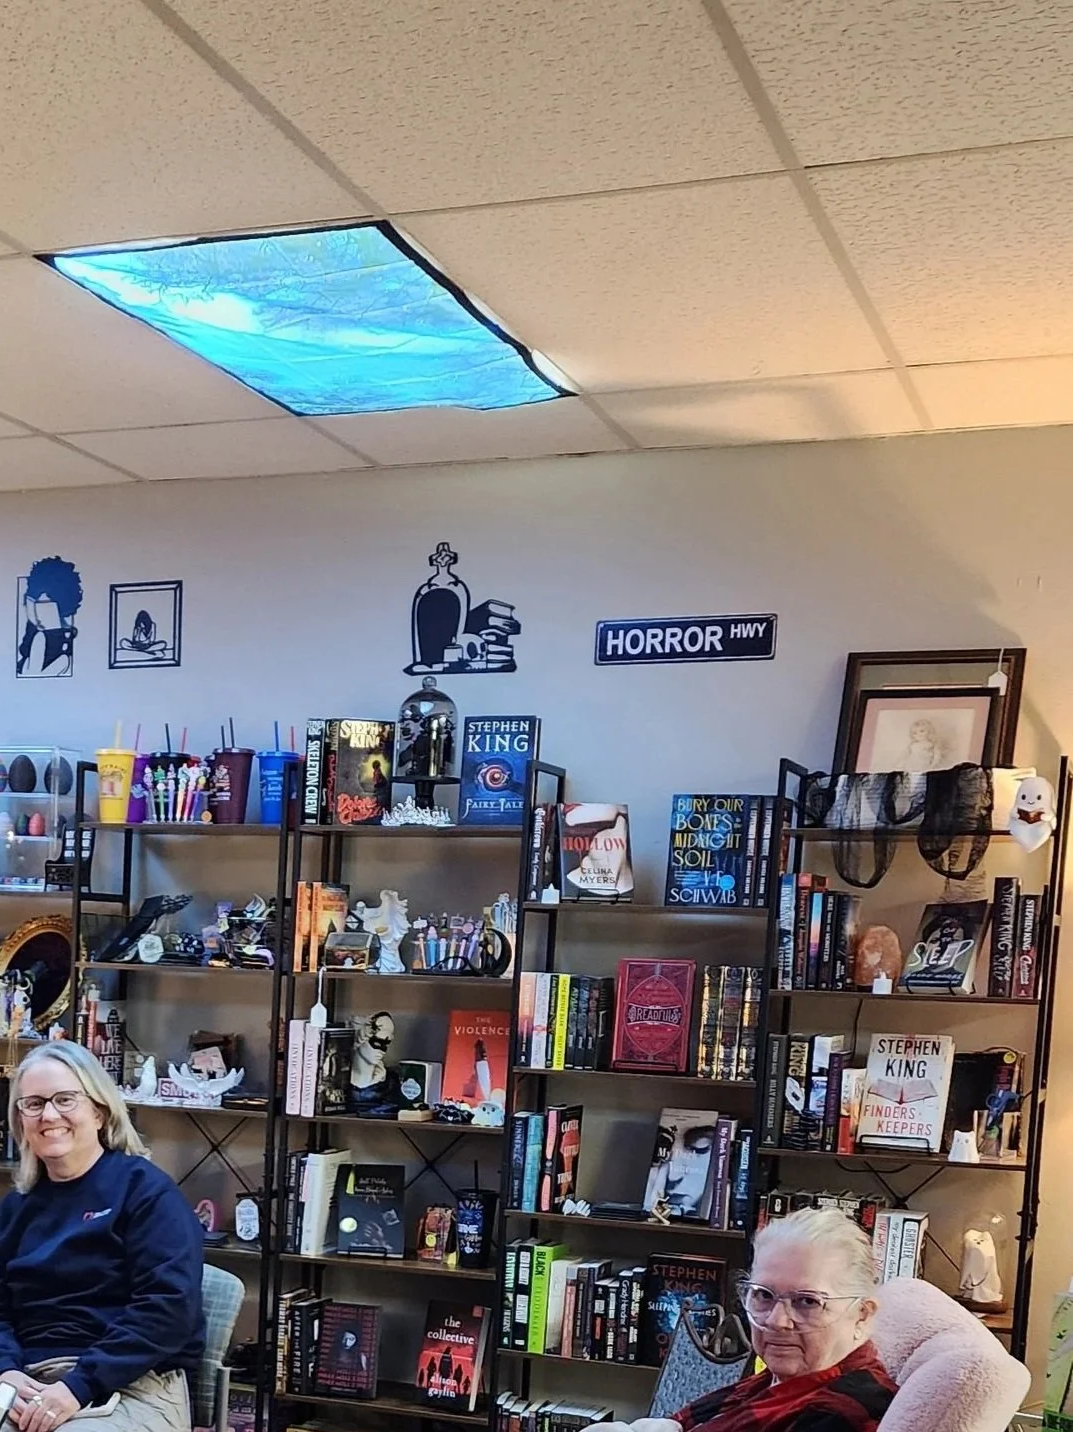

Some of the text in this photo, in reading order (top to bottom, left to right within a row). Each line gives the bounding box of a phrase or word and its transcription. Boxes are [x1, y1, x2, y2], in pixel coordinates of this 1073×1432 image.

[606, 622, 767, 656] HORROR HWY
[468, 721, 530, 733] STEPHEN
[467, 734, 529, 752] KING
[306, 740, 321, 785] SKELETON
[304, 786, 319, 814] CREW
[462, 798, 524, 819] FAIRY TALE
[677, 798, 744, 811] BURY OUR
[675, 813, 733, 831] BONES
[563, 836, 625, 851] HOLLOW
[673, 833, 742, 850] MIDNIGHT
[672, 850, 715, 868] SOIL
[580, 867, 613, 875] CELINA
[578, 876, 616, 884] MYERS
[669, 888, 737, 904] SCHWAB
[1023, 899, 1035, 932] STEPHEN
[997, 924, 1013, 951] KING
[1022, 932, 1032, 951] KING
[454, 1026, 511, 1036] VIOLENCE
[877, 1038, 942, 1056] STEPHEN
[788, 1041, 801, 1077] KING
[885, 1059, 927, 1078] KING
[768, 1079, 777, 1096] BILLY
[767, 1096, 776, 1129] SUMMERS
[863, 1104, 916, 1119] FINDERS
[877, 1121, 933, 1136] KEEPERS
[658, 1147, 672, 1161] My
[717, 1127, 728, 1179] My Dark Vanessa
[535, 1251, 546, 1276] BLACK
[651, 1264, 717, 1280] STEPHEN
[664, 1280, 703, 1293] KING
[619, 1280, 630, 1326] Grady Hendrix
[444, 1315, 461, 1328] the
[427, 1328, 475, 1345] collective
[293, 1350, 301, 1374] FIRE
[430, 1372, 458, 1386] alison
[427, 1385, 456, 1399] gaylin
